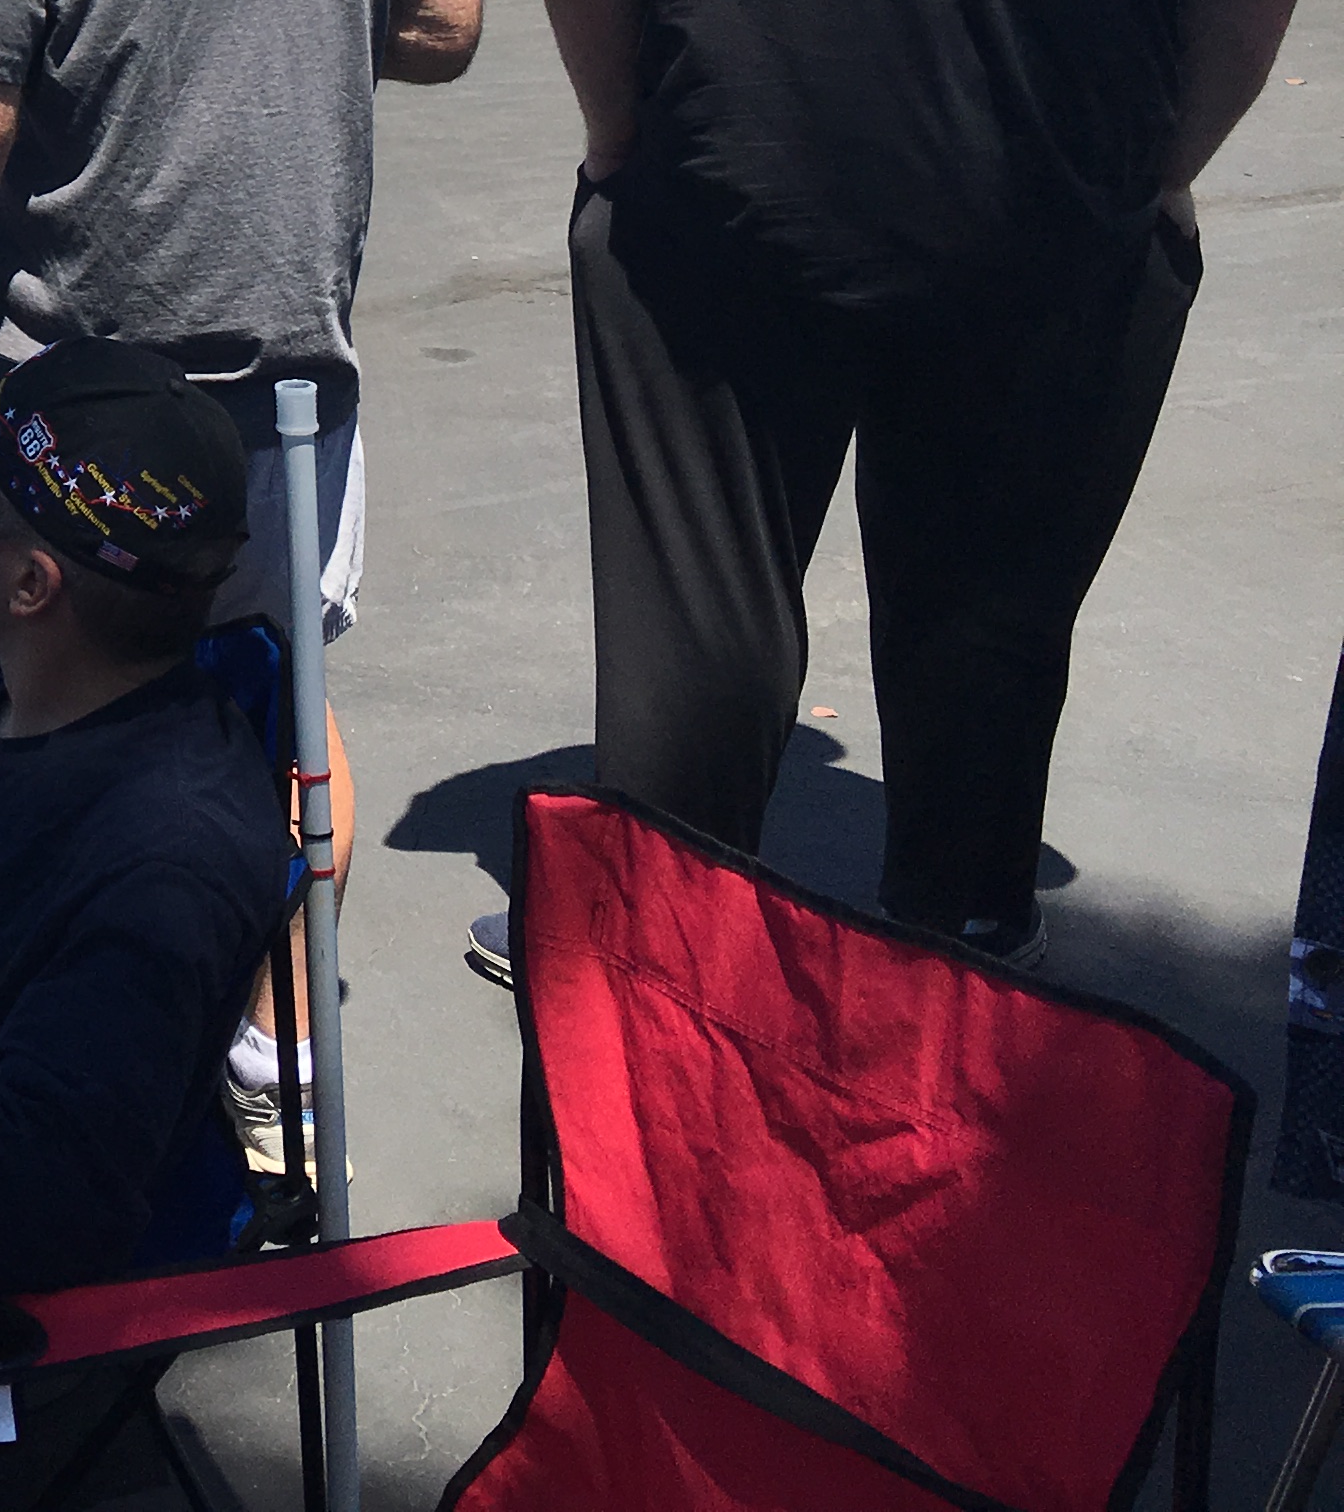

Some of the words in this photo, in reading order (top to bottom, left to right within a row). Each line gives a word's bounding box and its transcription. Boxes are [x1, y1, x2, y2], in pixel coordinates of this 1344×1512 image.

[21, 428, 41, 458] 66
[32, 420, 50, 447] ROUTE
[70, 491, 111, 536] Oklahoma
[133, 506, 159, 530] Louis
